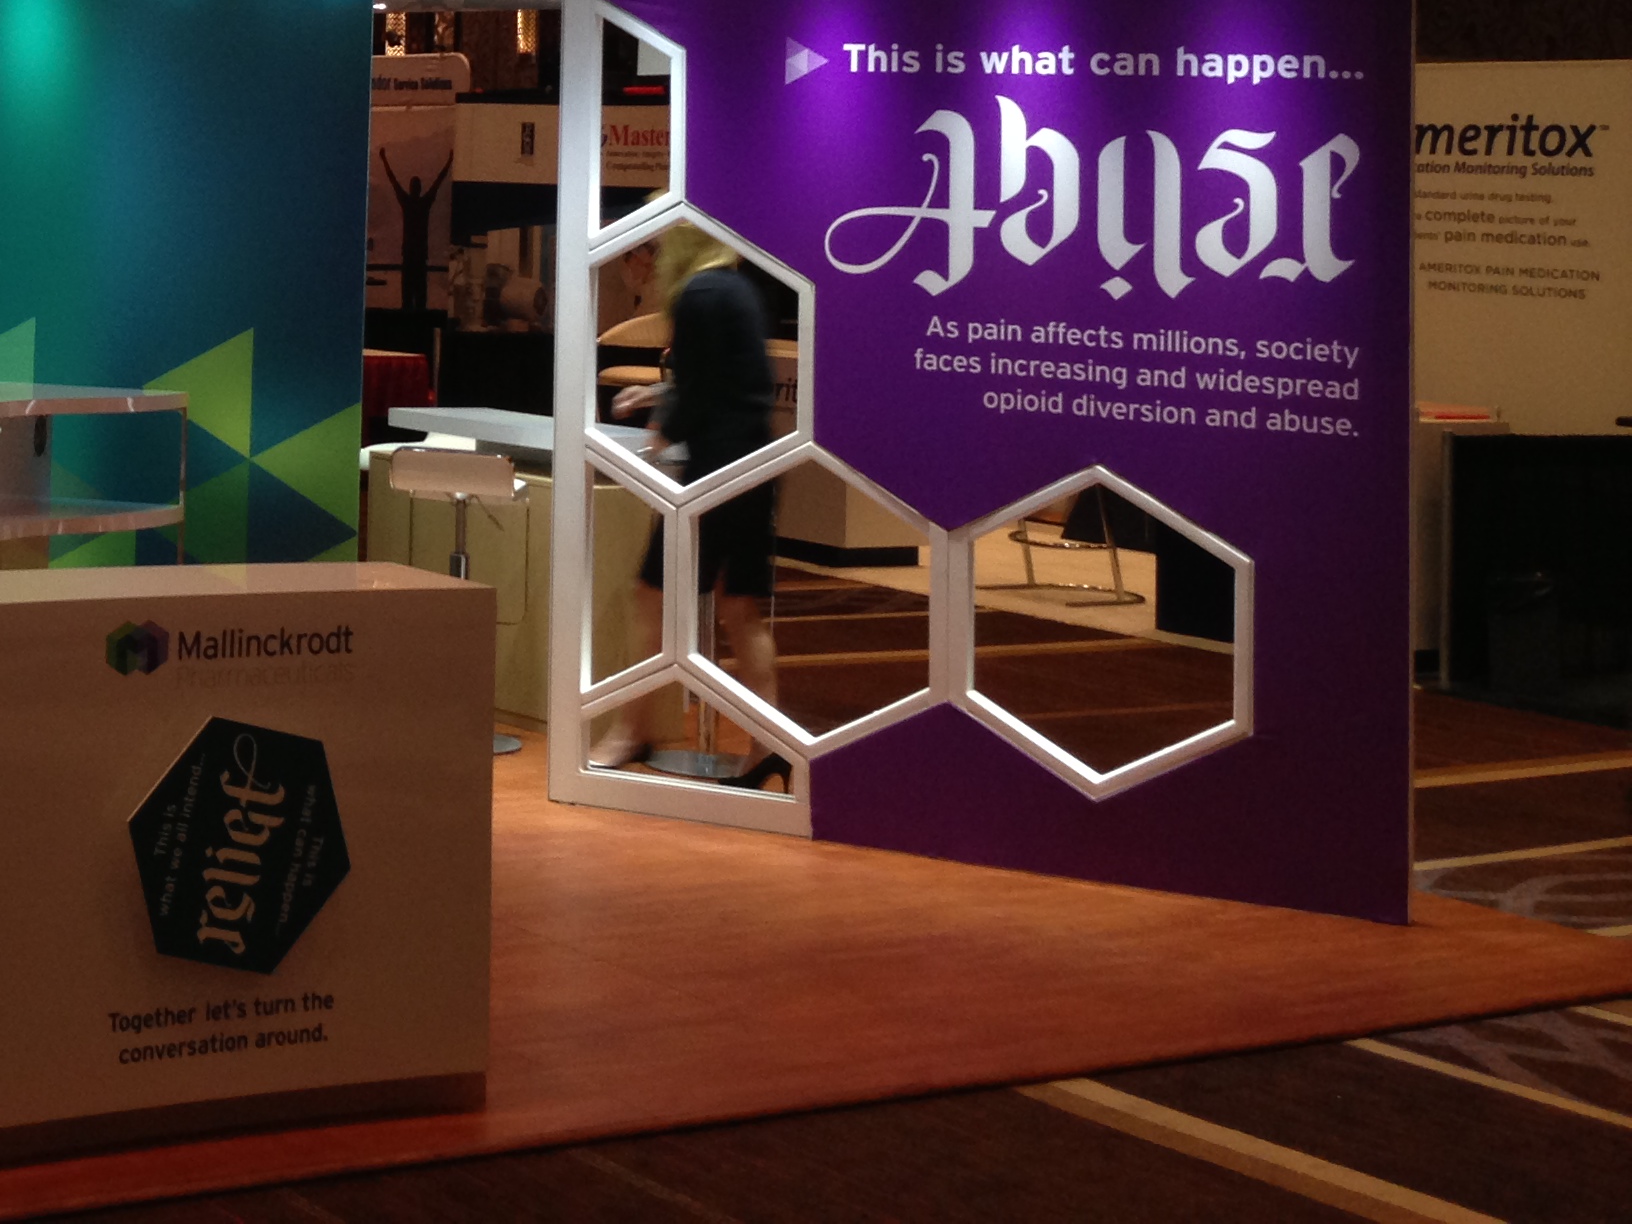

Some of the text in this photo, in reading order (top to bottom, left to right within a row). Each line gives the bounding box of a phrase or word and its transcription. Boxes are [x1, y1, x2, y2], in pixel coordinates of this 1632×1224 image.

[842, 42, 1365, 86] This is what can happen...
[1414, 160, 1595, 179] ation Monitoring Solutions
[1425, 209, 1496, 224] complete
[1444, 229, 1477, 244] pain
[1481, 230, 1567, 247] medication
[1419, 262, 1601, 282] AMERITOX PAIN MEDICATION
[1428, 280, 1587, 300] MONITORING SOLUTIONS
[926, 315, 1361, 370] As pain affects millions, society
[914, 348, 1361, 404] faces increasing and widespread
[983, 388, 1361, 439] opioid diversion and abuse.
[177, 624, 355, 661] Mallinckrodt
[196, 732, 286, 955] relief
[159, 875, 178, 917] what
[170, 847, 184, 870] we
[107, 991, 335, 1035] Together let's turn the
[118, 1023, 329, 1065] conversation around.
